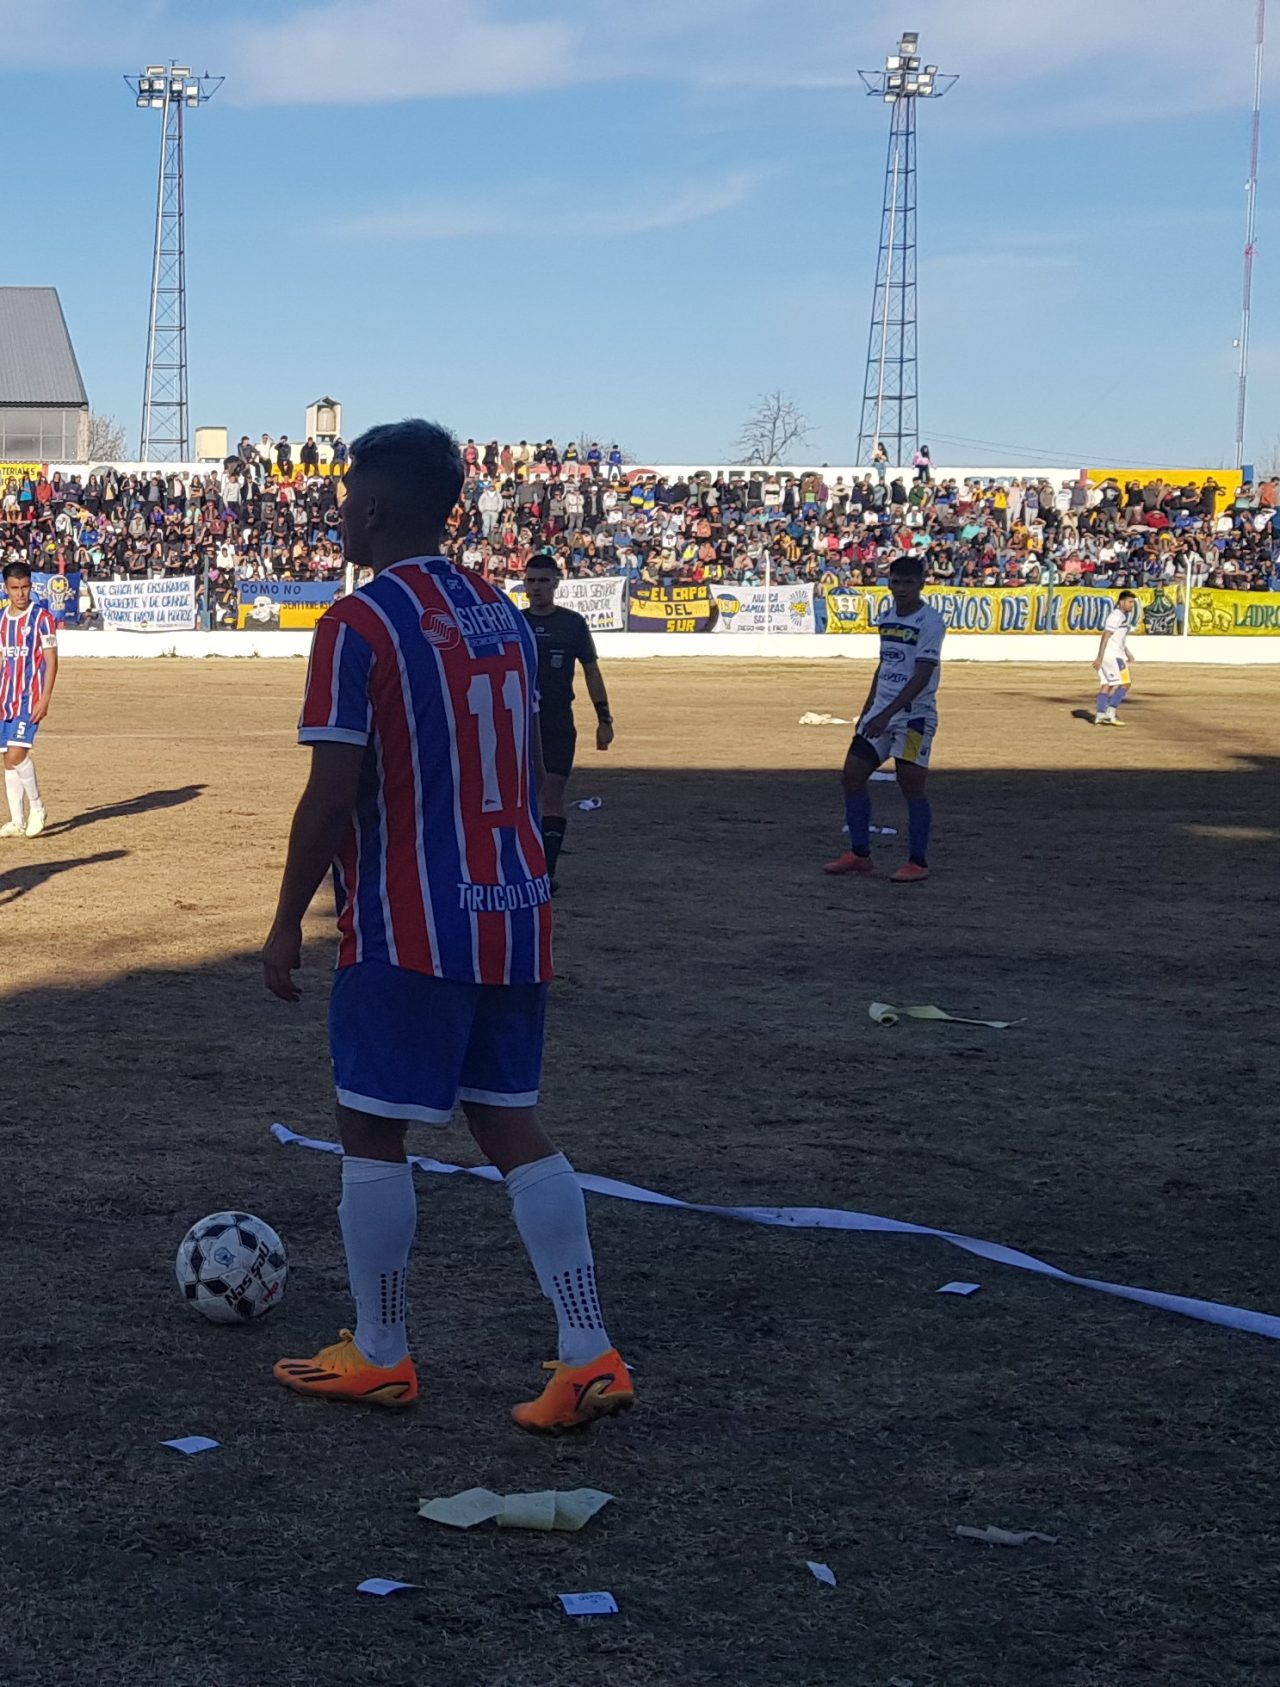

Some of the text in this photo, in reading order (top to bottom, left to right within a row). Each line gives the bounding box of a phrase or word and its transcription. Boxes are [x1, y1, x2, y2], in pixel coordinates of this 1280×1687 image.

[241, 583, 301, 595] COMO NO
[650, 586, 707, 601] EL CAPO
[752, 592, 779, 603] NUCA
[664, 603, 692, 616] DEL
[1000, 594, 1029, 632] DE
[1034, 594, 1062, 631] LA
[666, 619, 696, 633] SUR
[753, 614, 773, 624] SOO
[16, 721, 27, 735] 5
[466, 670, 525, 813] 11
